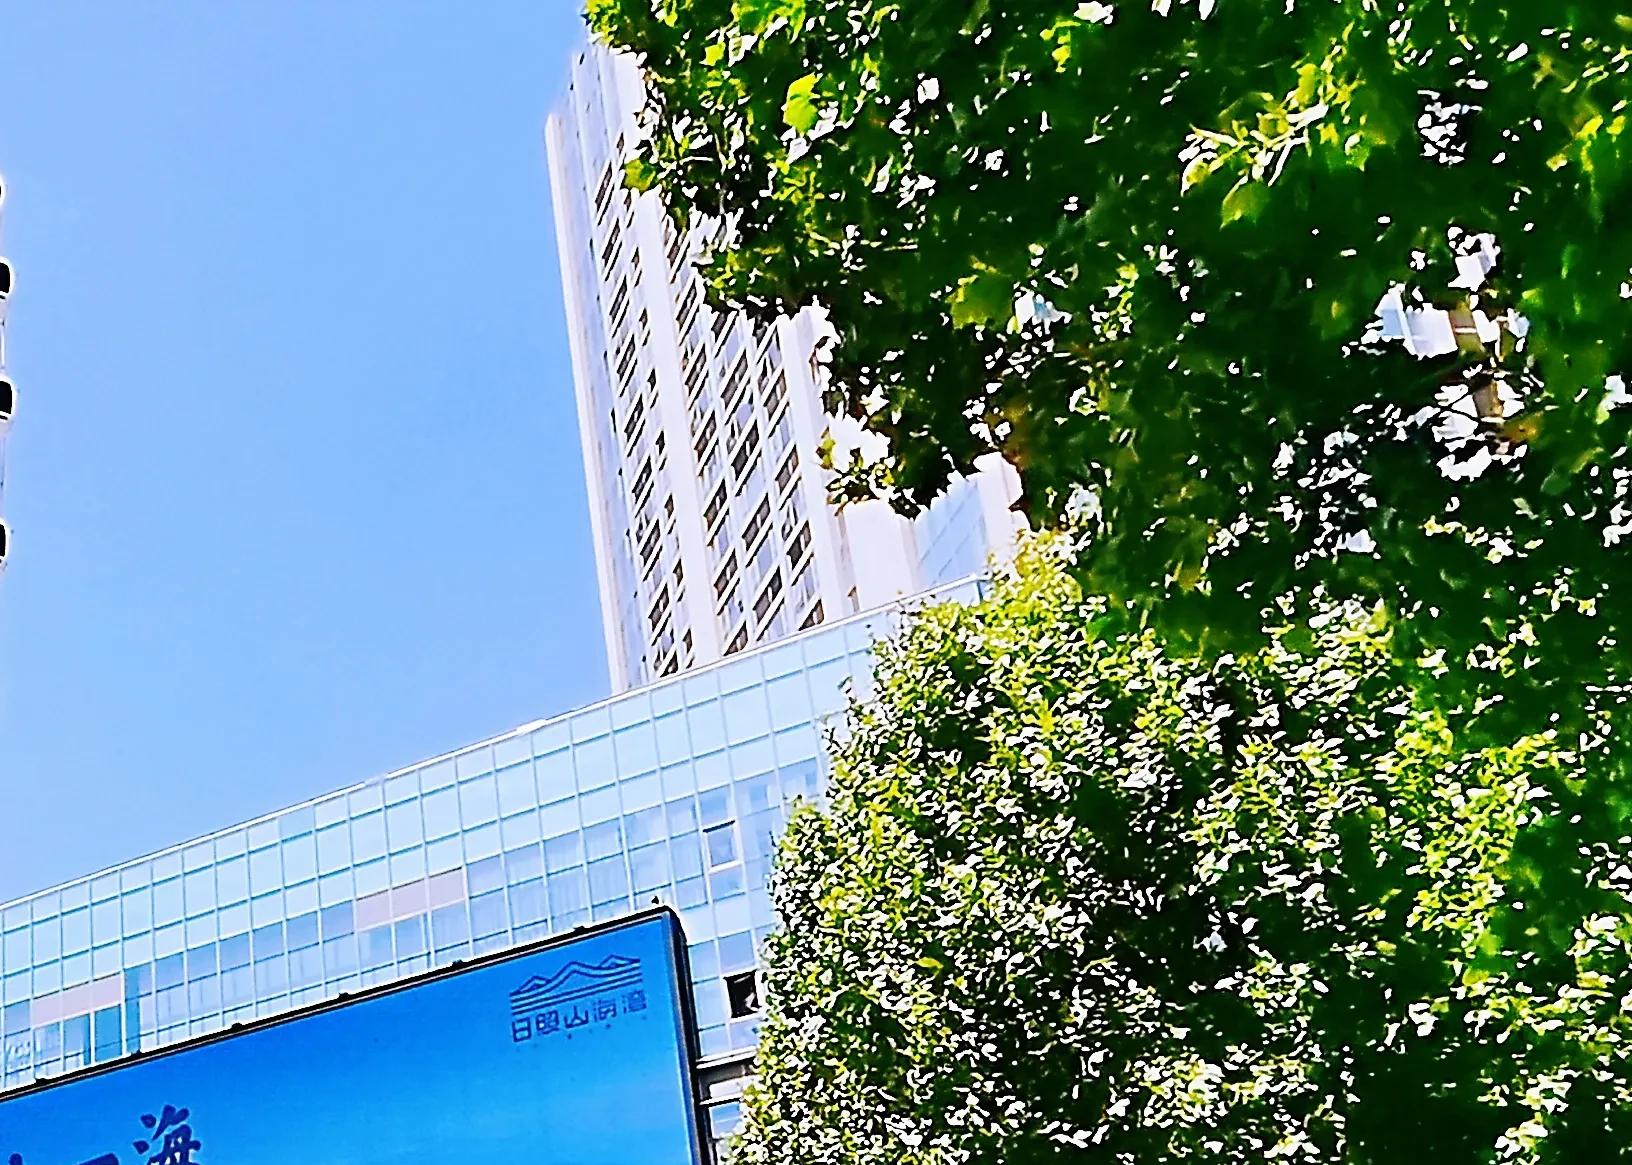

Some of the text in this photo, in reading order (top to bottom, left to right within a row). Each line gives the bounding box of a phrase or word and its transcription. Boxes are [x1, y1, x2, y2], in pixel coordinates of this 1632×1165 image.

[512, 990, 647, 1043] 日照山海湾
